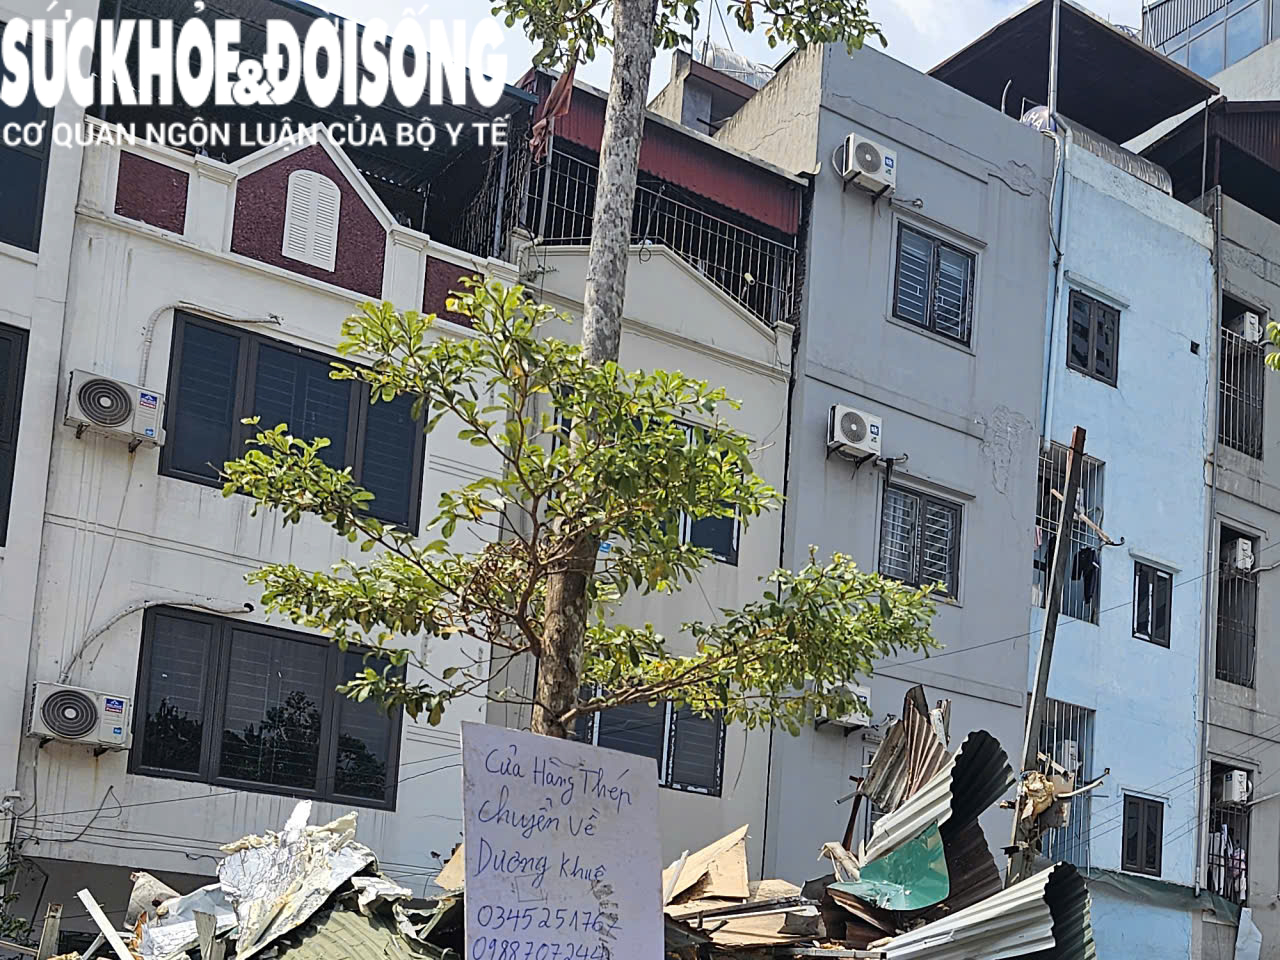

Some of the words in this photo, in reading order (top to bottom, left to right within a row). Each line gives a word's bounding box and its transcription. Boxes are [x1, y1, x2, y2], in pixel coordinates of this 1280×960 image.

[485, 744, 526, 778] Cửa
[579, 767, 632, 815] Thép
[473, 837, 551, 888] Dương
